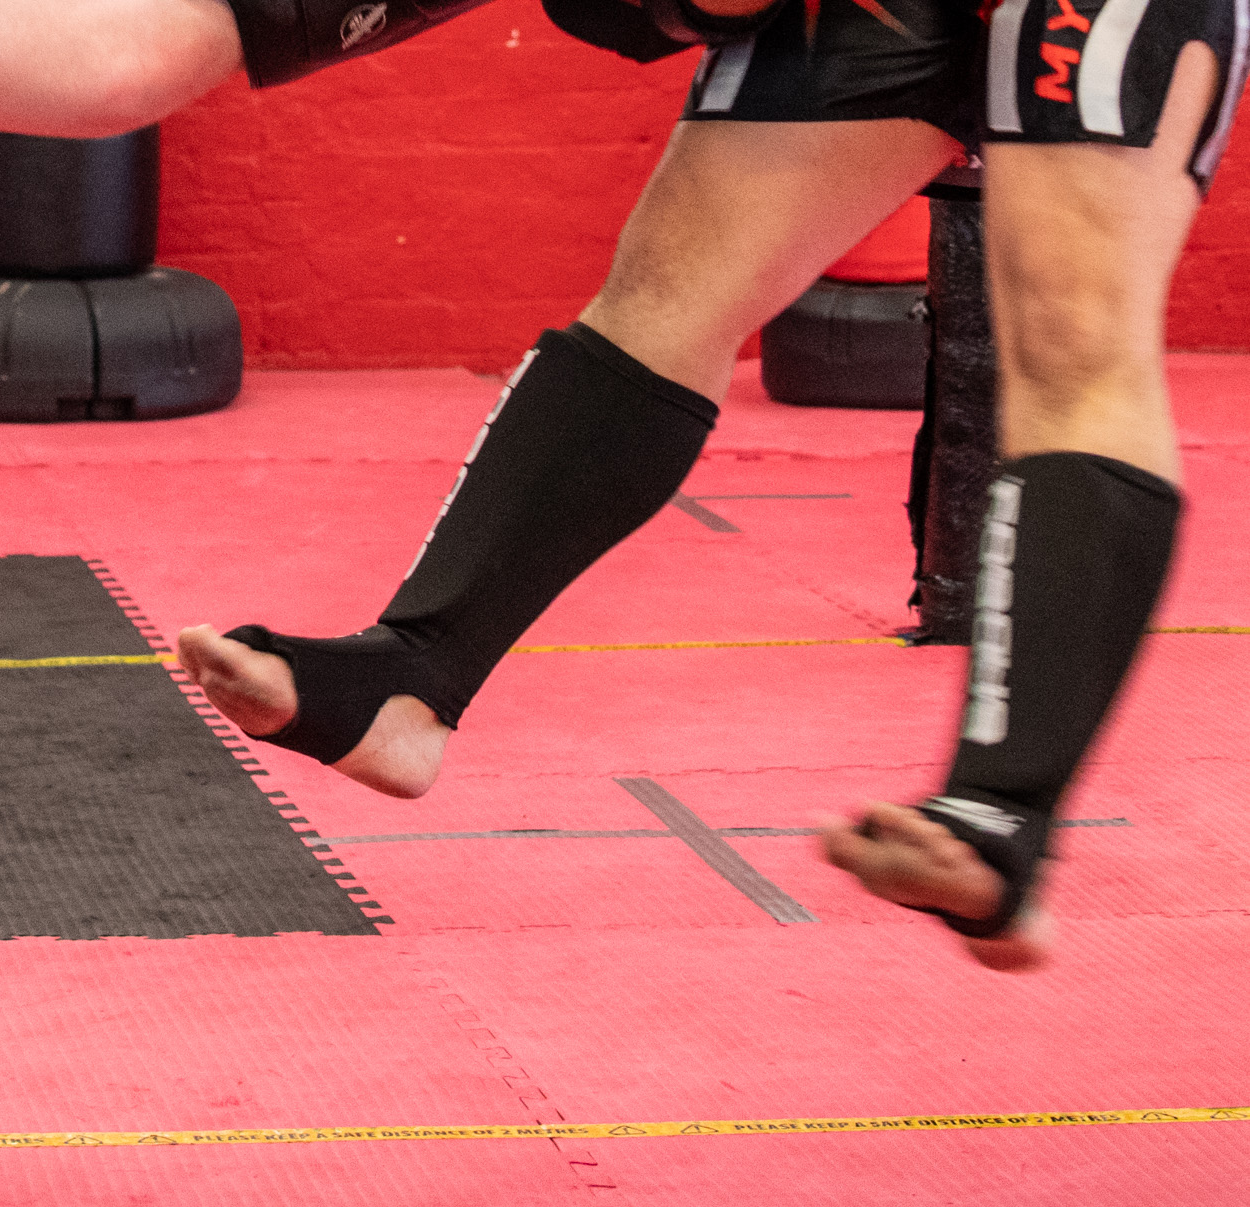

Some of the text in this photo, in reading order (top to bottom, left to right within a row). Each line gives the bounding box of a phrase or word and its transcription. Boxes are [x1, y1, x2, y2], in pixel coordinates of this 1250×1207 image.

[734, 1122, 801, 1131] PLEASE
[804, 1121, 850, 1130] KEEP
[870, 1119, 914, 1128] SAFE
[917, 1116, 1006, 1127] DISTANCE
[1007, 1116, 1031, 1124] OF
[1050, 1114, 1122, 1123] METRES
[193, 1134, 262, 1142] PLEASE
[264, 1132, 311, 1141] KEEP
[332, 1130, 376, 1139] SAFE
[381, 1129, 469, 1138] DISTANCE
[516, 1127, 589, 1136] METRES
